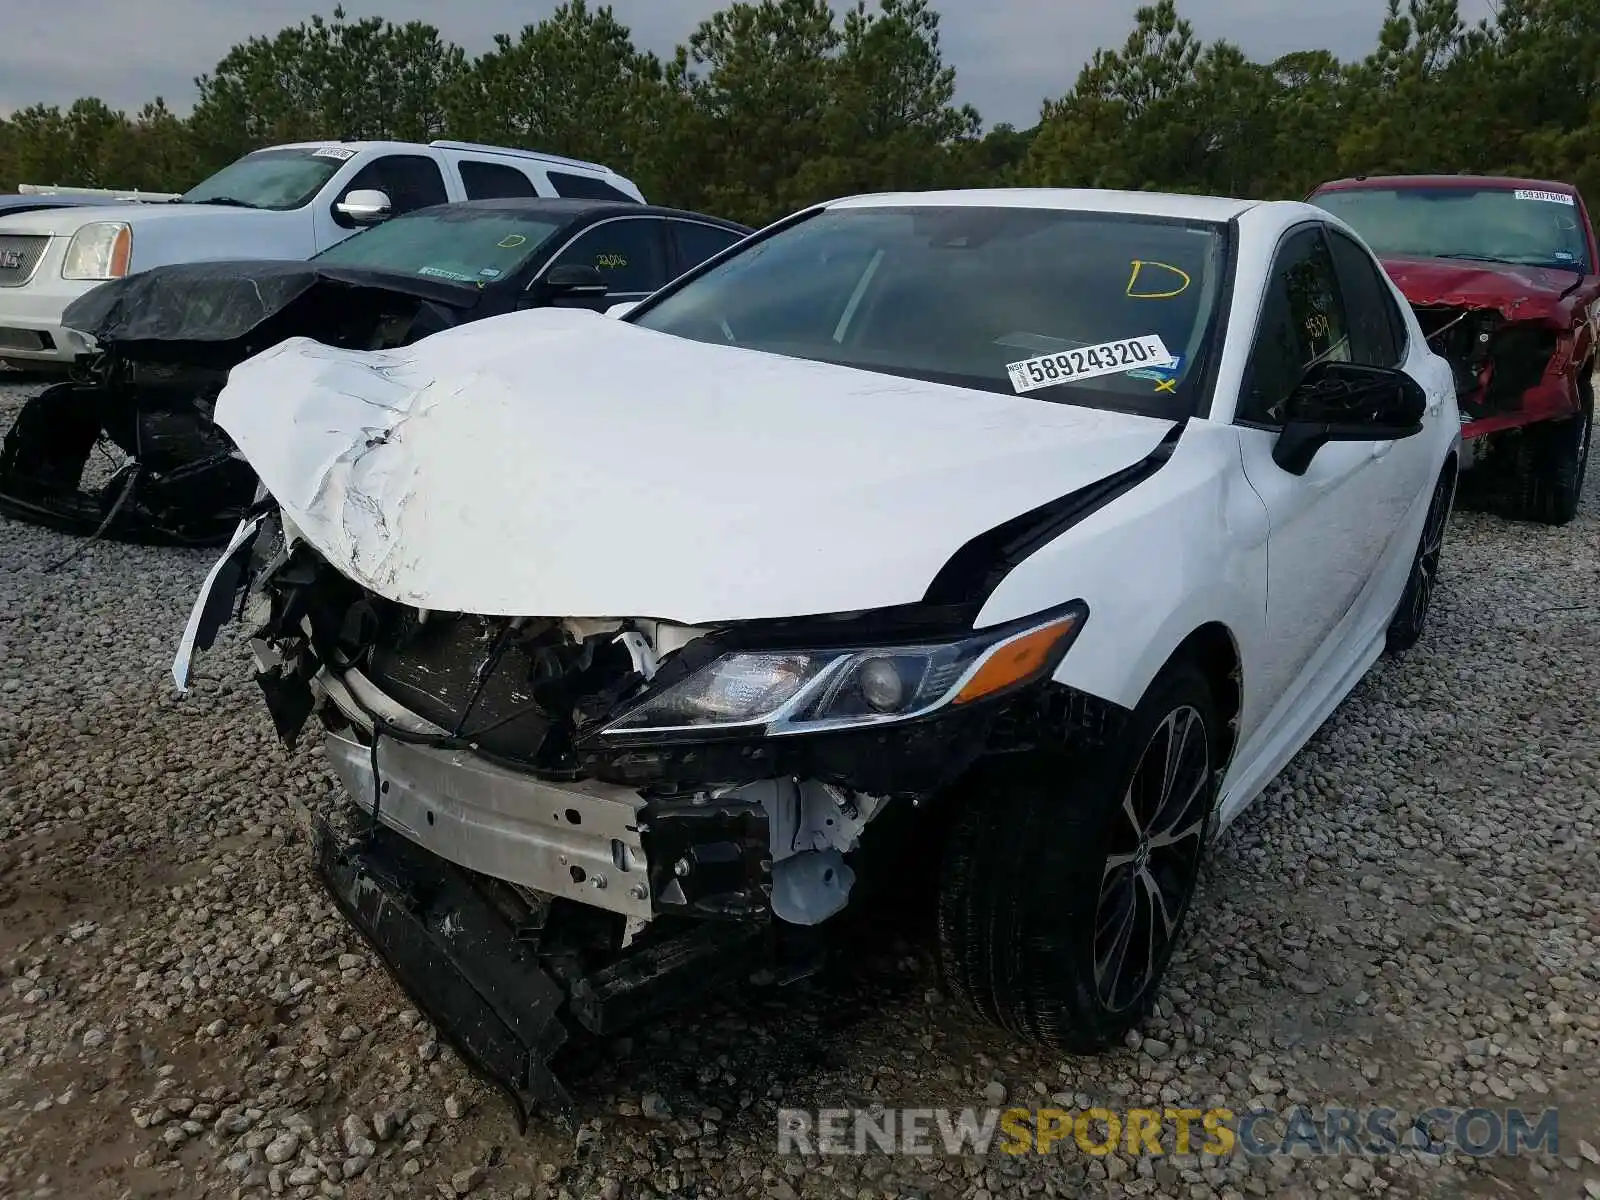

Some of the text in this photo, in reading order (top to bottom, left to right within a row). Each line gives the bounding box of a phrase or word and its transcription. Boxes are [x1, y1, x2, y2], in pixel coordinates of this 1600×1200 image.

[1126, 260, 1190, 298] D
[1008, 362, 1024, 372] NSP
[1026, 341, 1147, 383] 58924320
[1145, 345, 1157, 357] F
